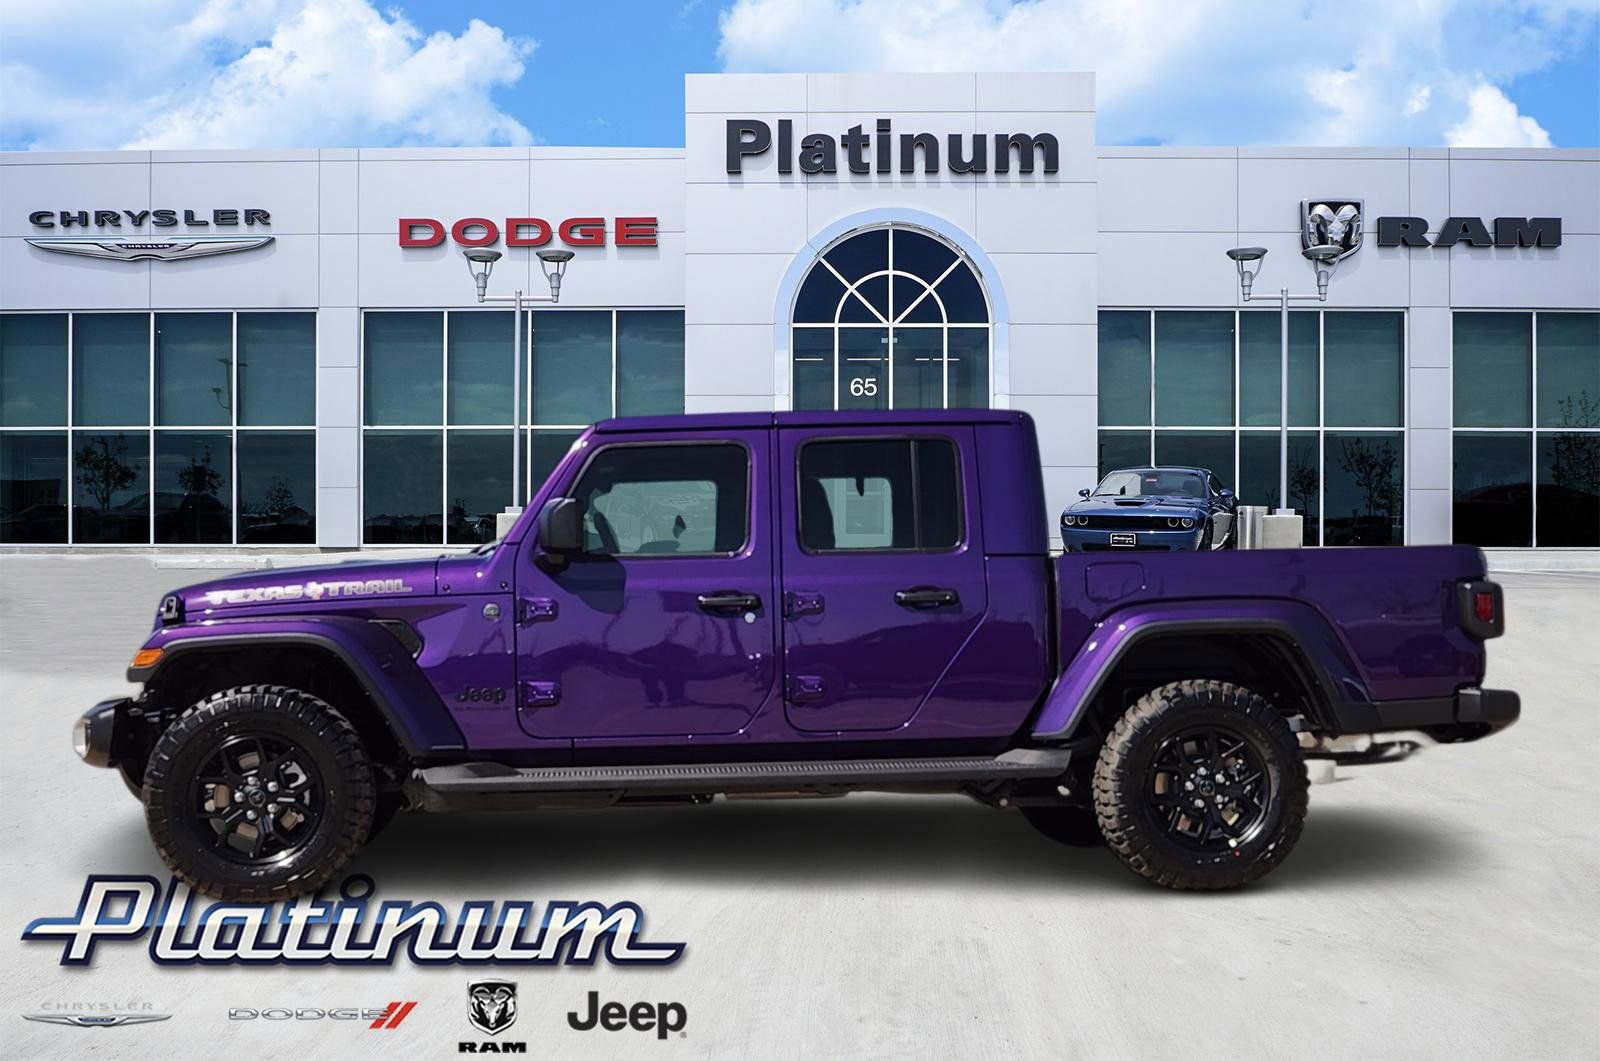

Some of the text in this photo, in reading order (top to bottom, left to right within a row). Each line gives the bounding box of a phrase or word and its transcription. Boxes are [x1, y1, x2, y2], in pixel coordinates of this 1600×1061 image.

[725, 119, 1060, 175] Platinum
[29, 209, 272, 227] CHRYSLER
[399, 217, 658, 248] DODGE
[1377, 216, 1562, 248] RAM
[850, 377, 878, 397] 65
[205, 579, 412, 605] TEXAS TRAIL
[456, 685, 506, 704] Jeep
